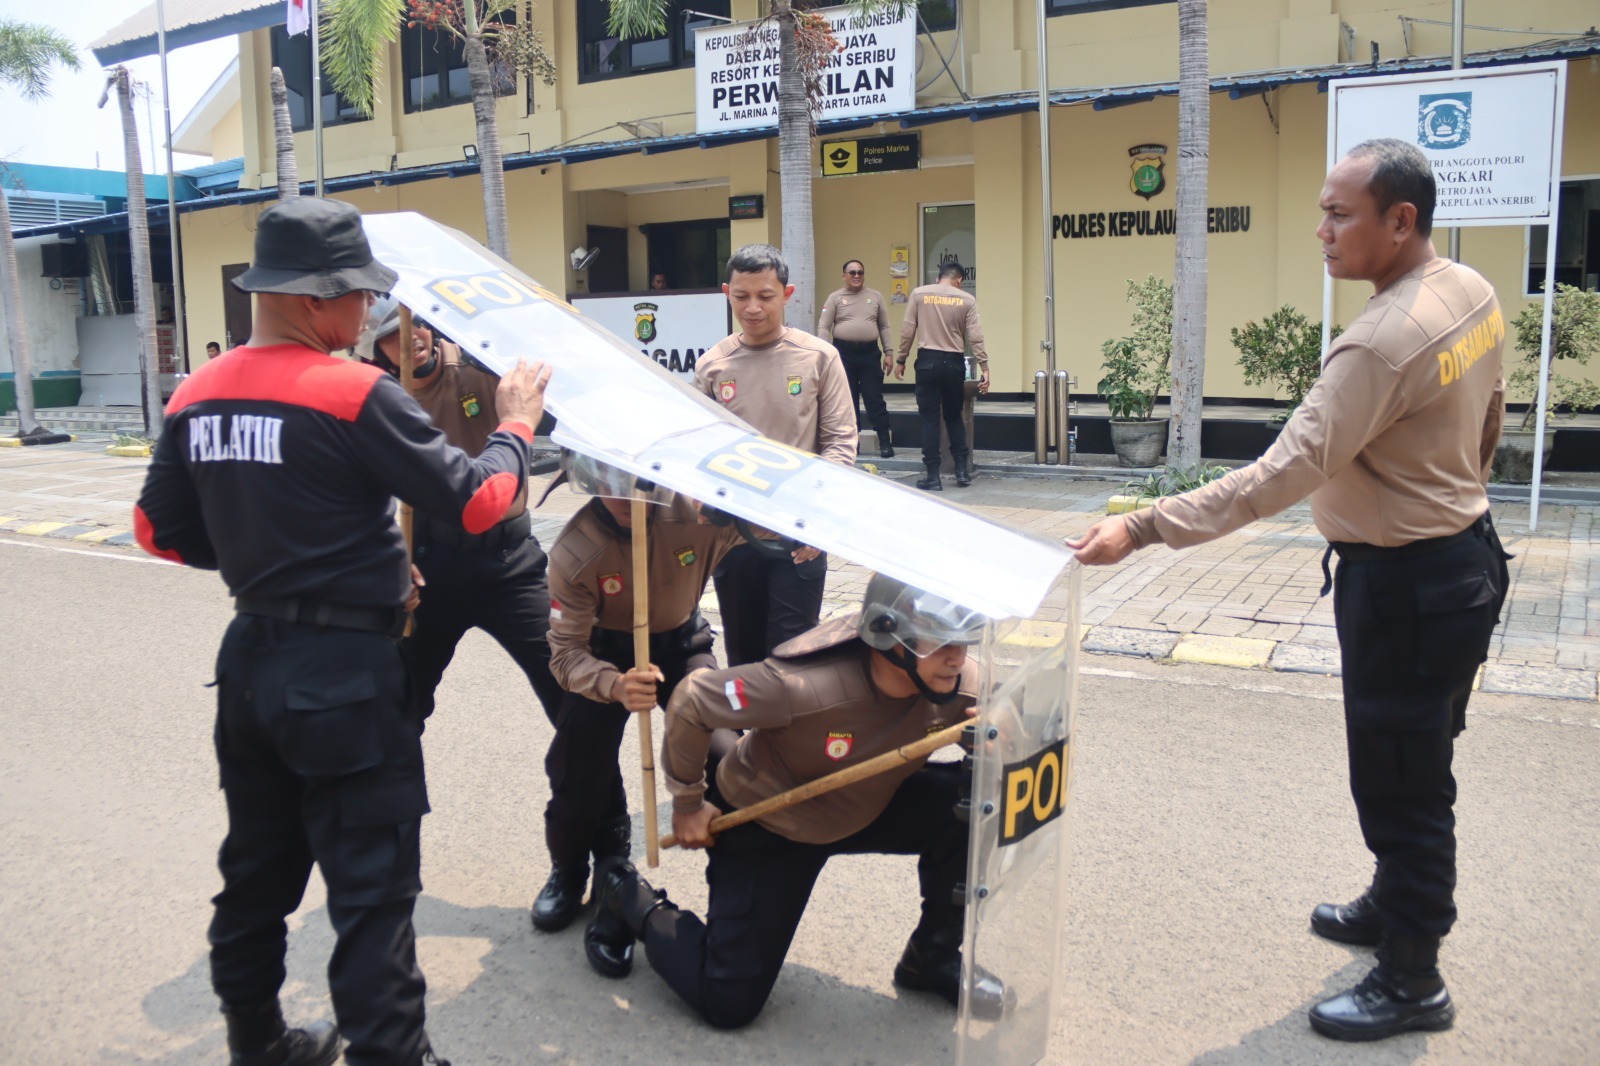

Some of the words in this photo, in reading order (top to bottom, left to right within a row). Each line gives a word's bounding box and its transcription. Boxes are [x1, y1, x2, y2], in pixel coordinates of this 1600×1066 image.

[849, 10, 903, 30] INDONESIA
[726, 46, 780, 65] DAERAH
[844, 33, 877, 49] JAYA
[711, 66, 759, 84] RESORT
[846, 48, 896, 66] SERIBU
[719, 111, 731, 121] JL.
[733, 107, 768, 120] MARINA
[853, 93, 887, 106] UTARA
[863, 147, 885, 156] Polres
[886, 144, 910, 153] Marina
[863, 157, 883, 165] Police
[1445, 157, 1493, 168] ANGGOTA
[1494, 155, 1526, 165] POLRI
[1437, 169, 1494, 183] NGKARI
[1468, 186, 1493, 195] JAYA
[1440, 197, 1500, 208] KEPULAUAN
[1500, 195, 1538, 206] SERIBU
[1053, 212, 1106, 239] POLRES
[1207, 205, 1251, 233] ERIBU
[923, 294, 964, 306] DITSAMAPTA
[189, 414, 284, 464] PELATIH
